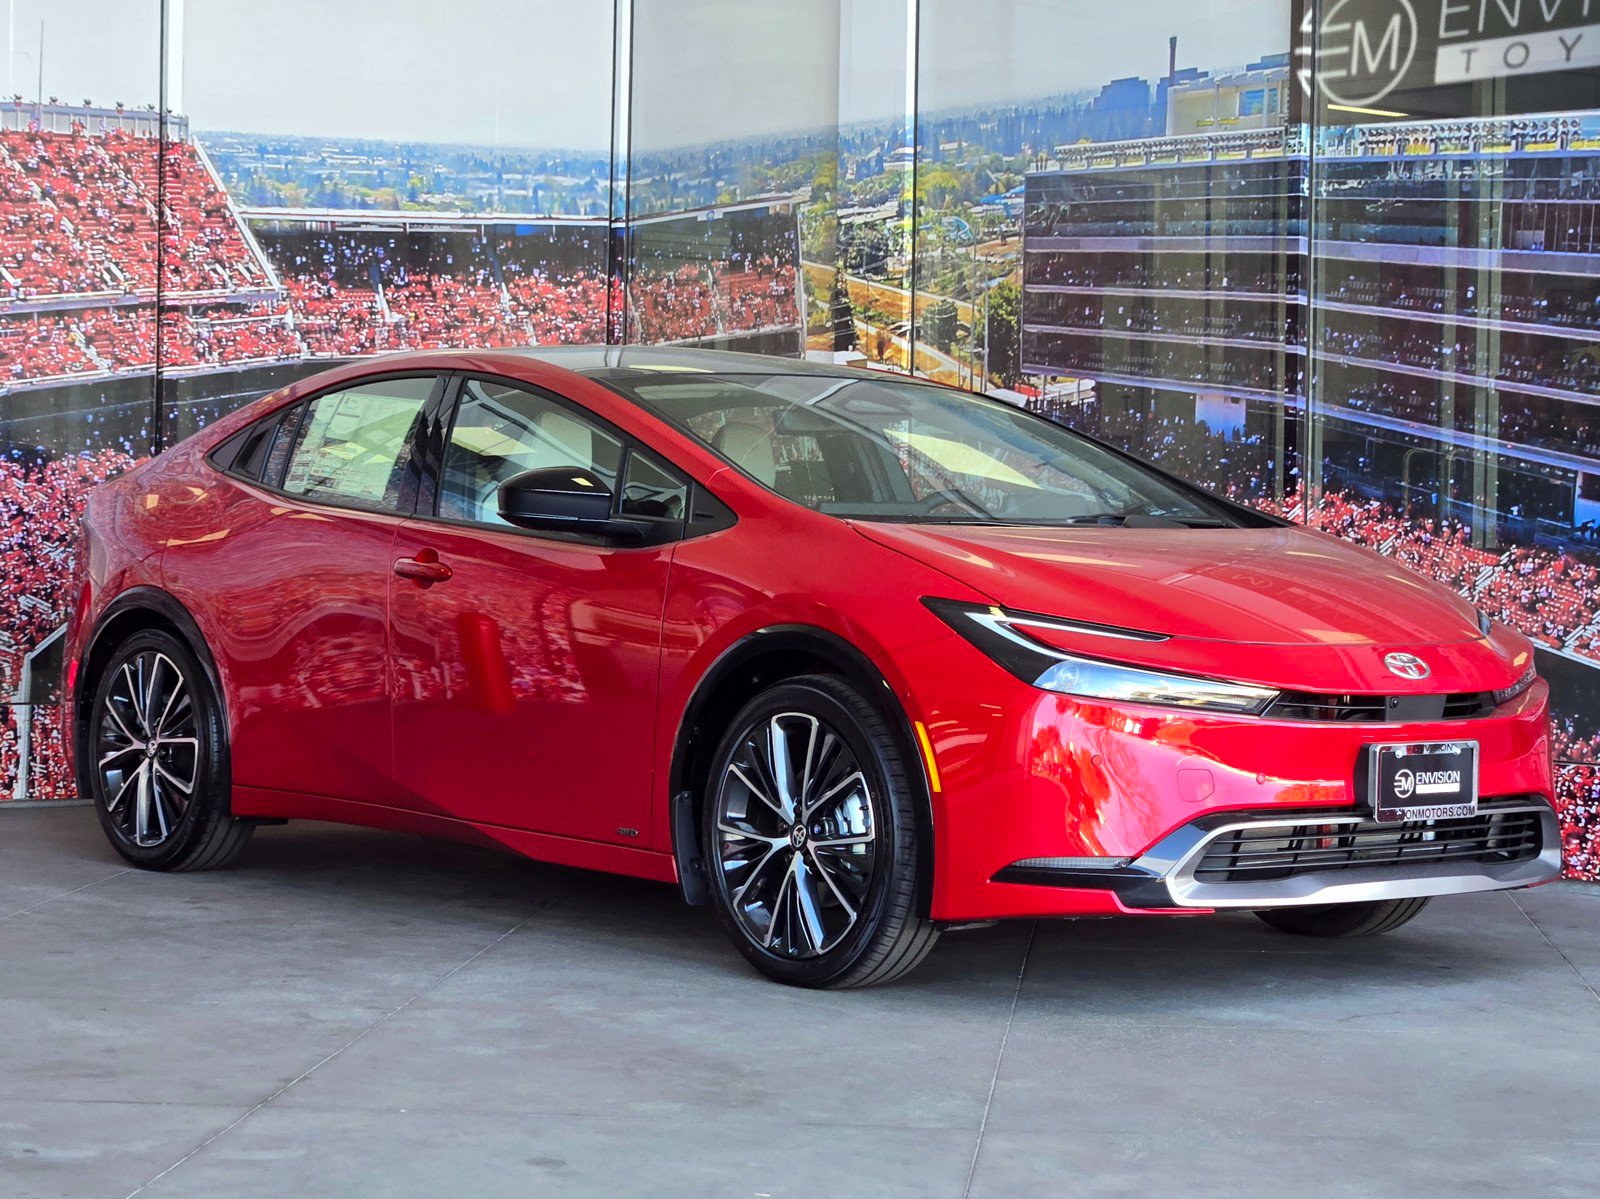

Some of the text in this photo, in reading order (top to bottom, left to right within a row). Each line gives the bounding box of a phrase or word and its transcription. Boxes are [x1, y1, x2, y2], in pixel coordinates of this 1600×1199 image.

[1460, 33, 1584, 74] TOY
[1415, 770, 1461, 785] ENVISION
[1403, 805, 1476, 820] ONMOTORS.COM
